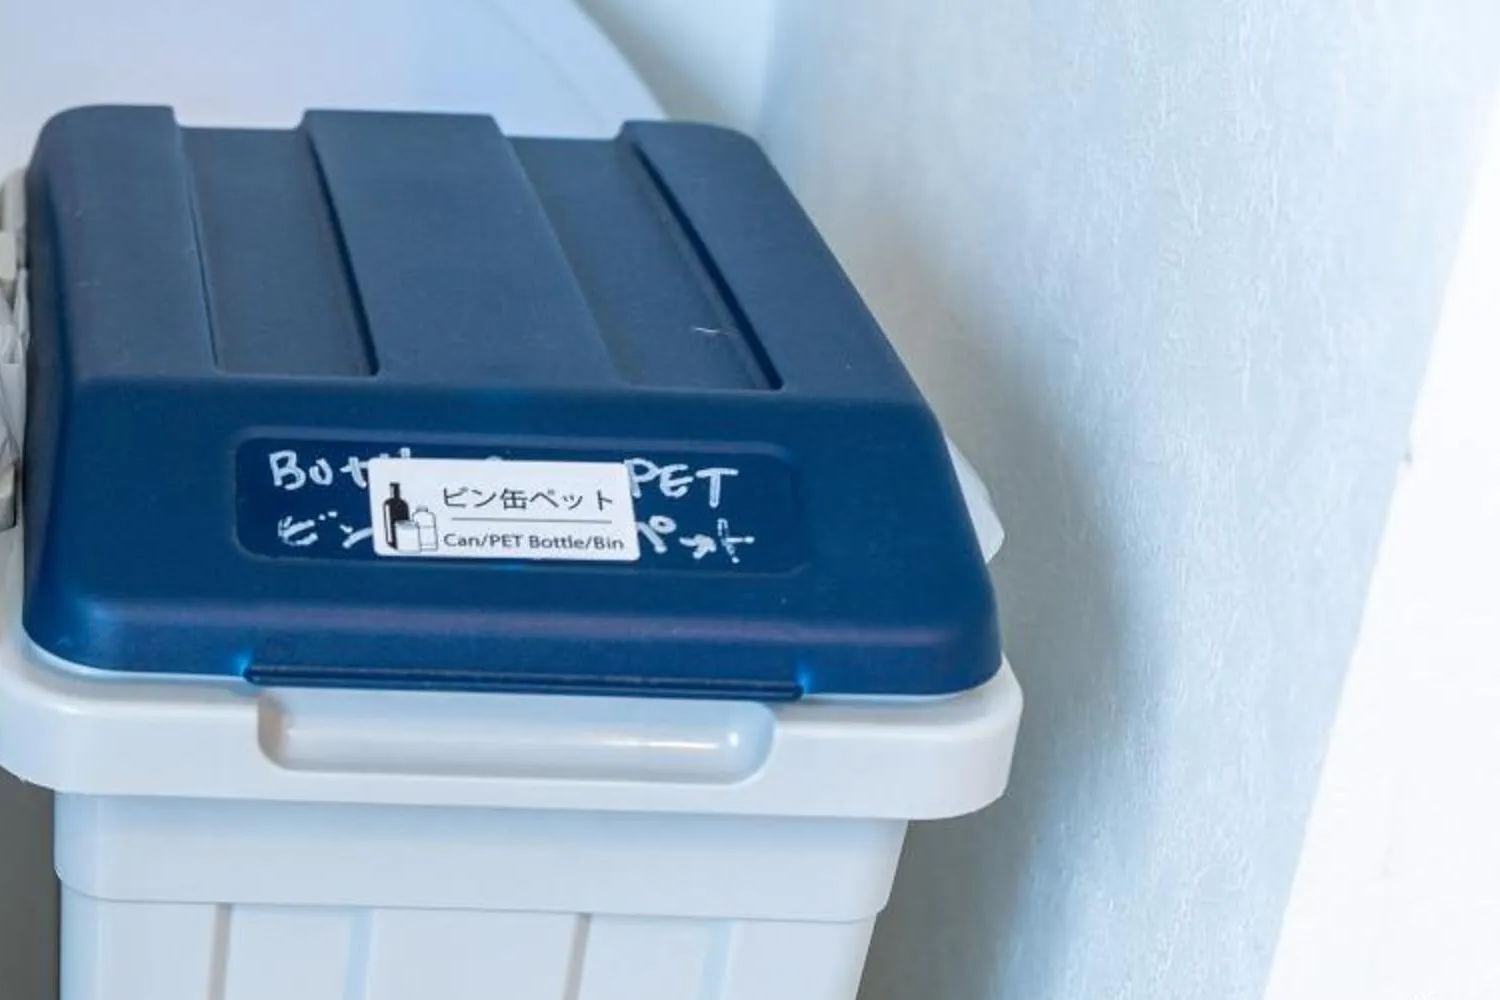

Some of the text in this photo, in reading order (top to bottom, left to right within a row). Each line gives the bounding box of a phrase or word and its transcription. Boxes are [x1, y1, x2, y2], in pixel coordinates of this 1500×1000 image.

[623, 457, 739, 508] PET
[443, 533, 624, 551] Can/PET Bottle/Bin
